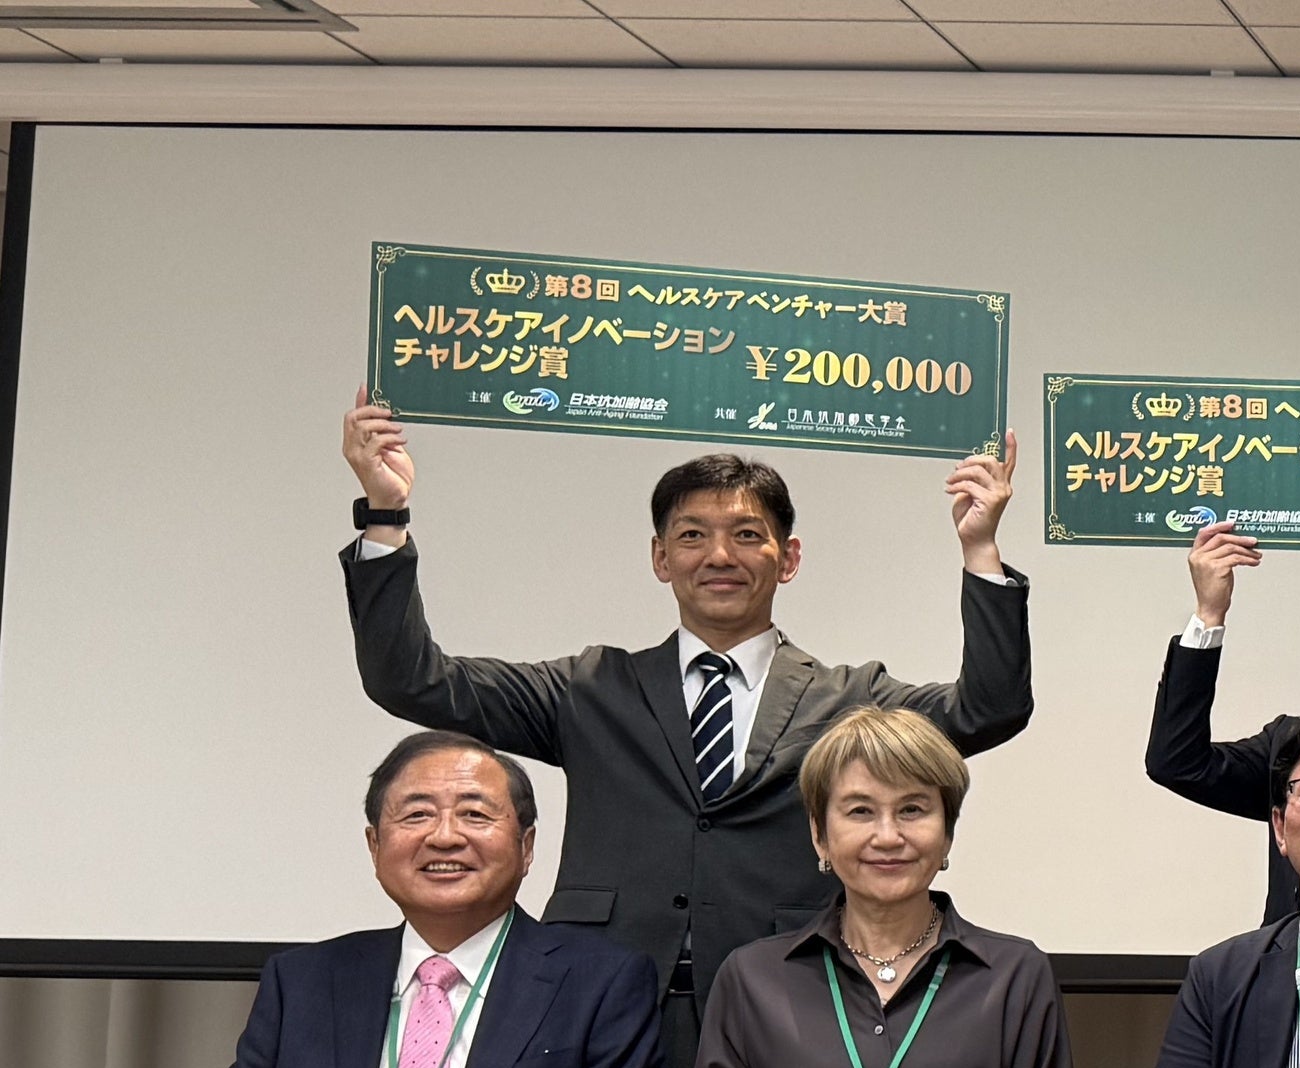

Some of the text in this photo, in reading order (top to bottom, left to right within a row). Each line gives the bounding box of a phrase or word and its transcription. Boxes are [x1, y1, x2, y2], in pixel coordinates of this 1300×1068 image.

[544, 274, 907, 327] 第8回 ヘルスケアベンチャー大賞
[394, 303, 736, 356] ヘルスケアイノベーション
[394, 338, 569, 379] チャレンジ賞
[745, 345, 973, 397] ¥200,000
[570, 393, 668, 411] 日本抗加齢協会
[1199, 394, 1267, 420] 第8回
[1066, 464, 1224, 498] チャレンジ賞
